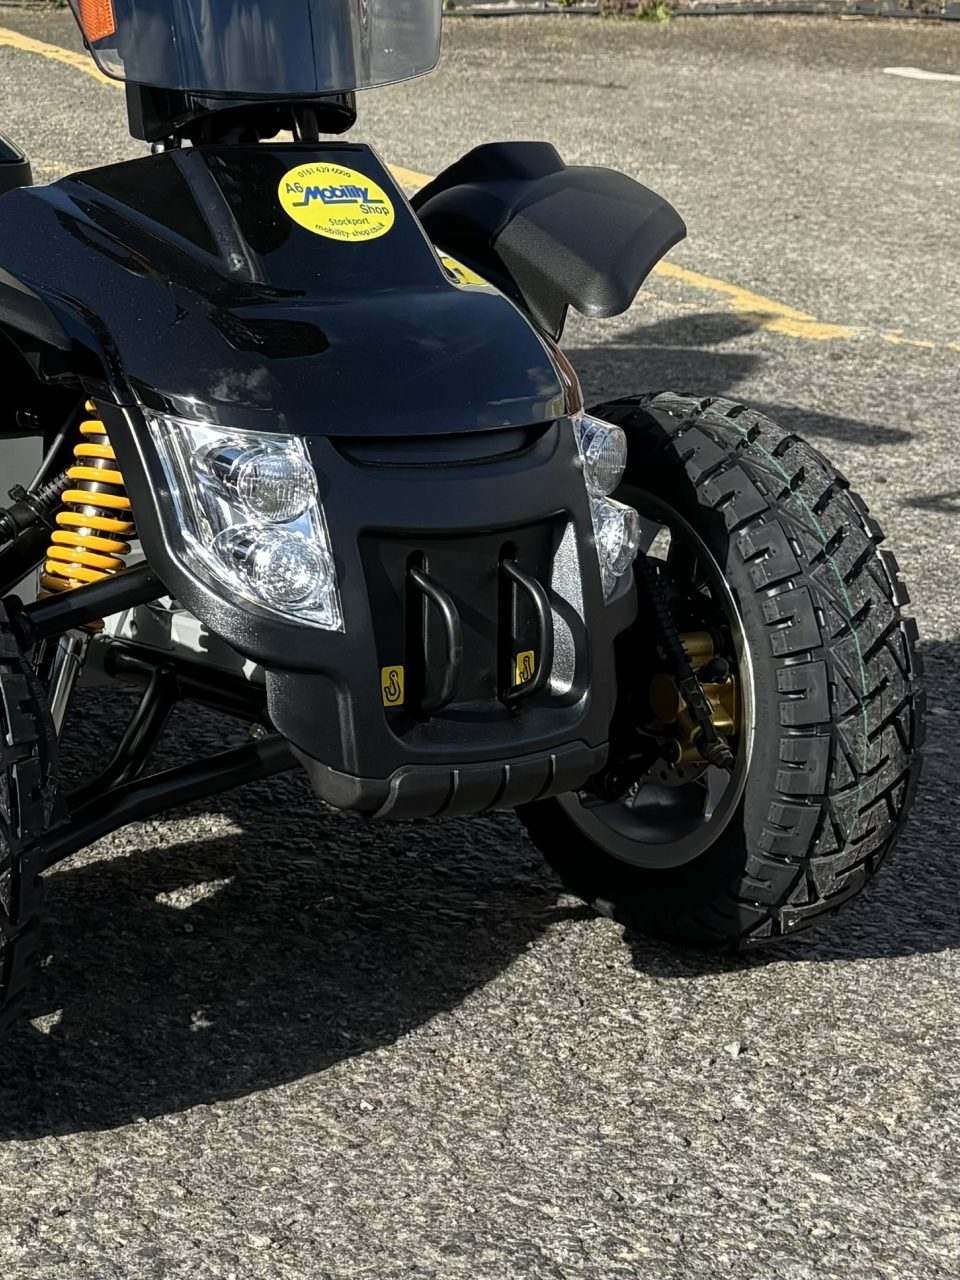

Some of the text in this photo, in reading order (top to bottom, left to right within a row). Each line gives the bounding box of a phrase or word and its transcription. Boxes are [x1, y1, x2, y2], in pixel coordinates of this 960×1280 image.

[285, 182, 369, 206] A6 Mobility
[360, 204, 389, 216] Shop
[329, 217, 369, 226] Stockport
